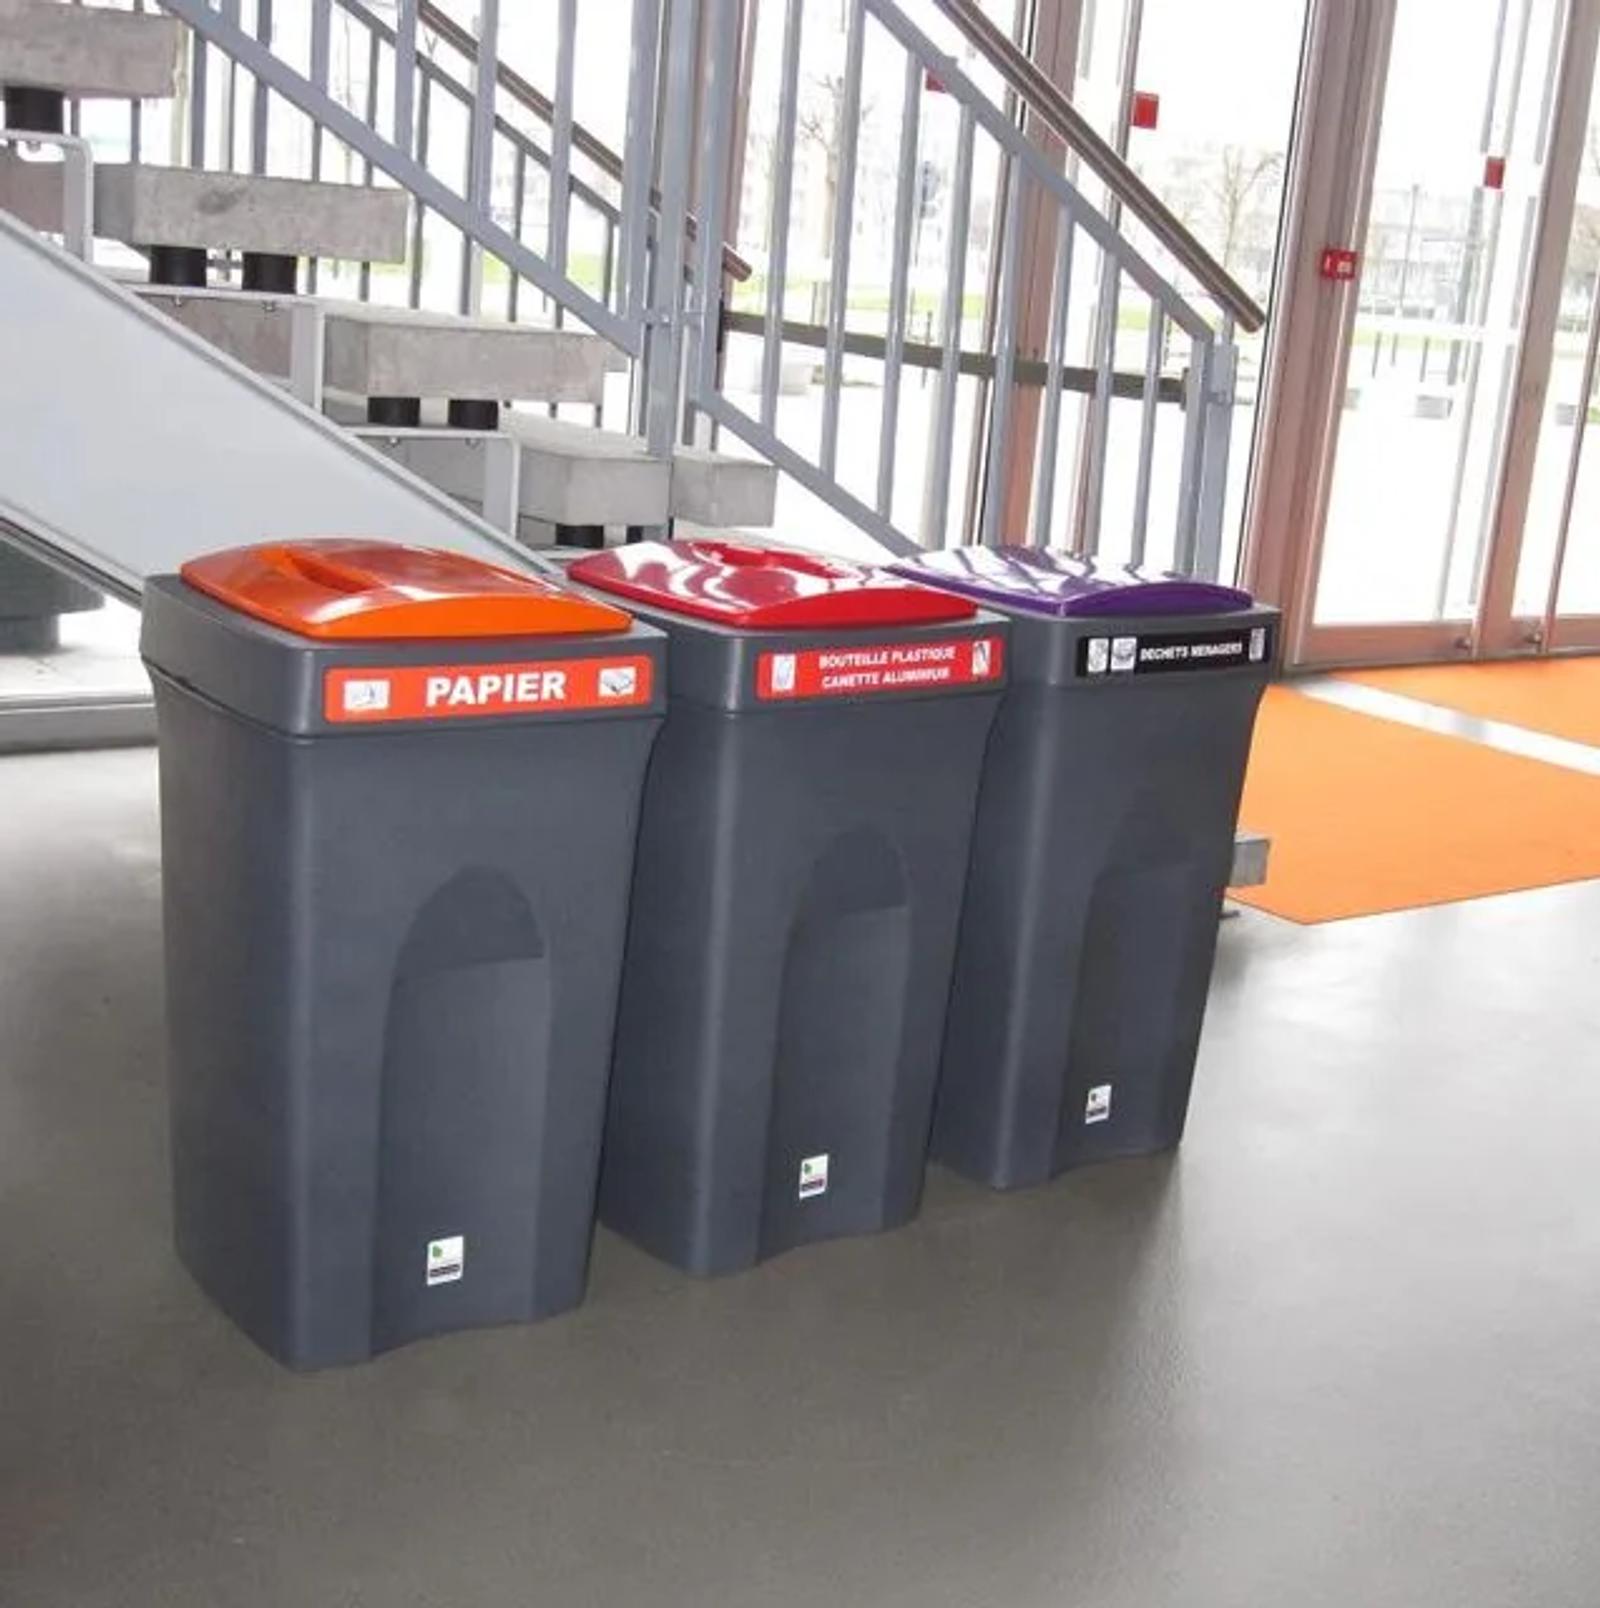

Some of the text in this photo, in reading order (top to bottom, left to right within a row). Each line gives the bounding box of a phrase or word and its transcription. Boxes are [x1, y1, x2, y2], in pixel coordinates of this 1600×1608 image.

[819, 646, 957, 669] BOUTEILLE PLASTIQUE
[426, 671, 567, 707] PAPIER
[822, 669, 879, 688] CANETTE
